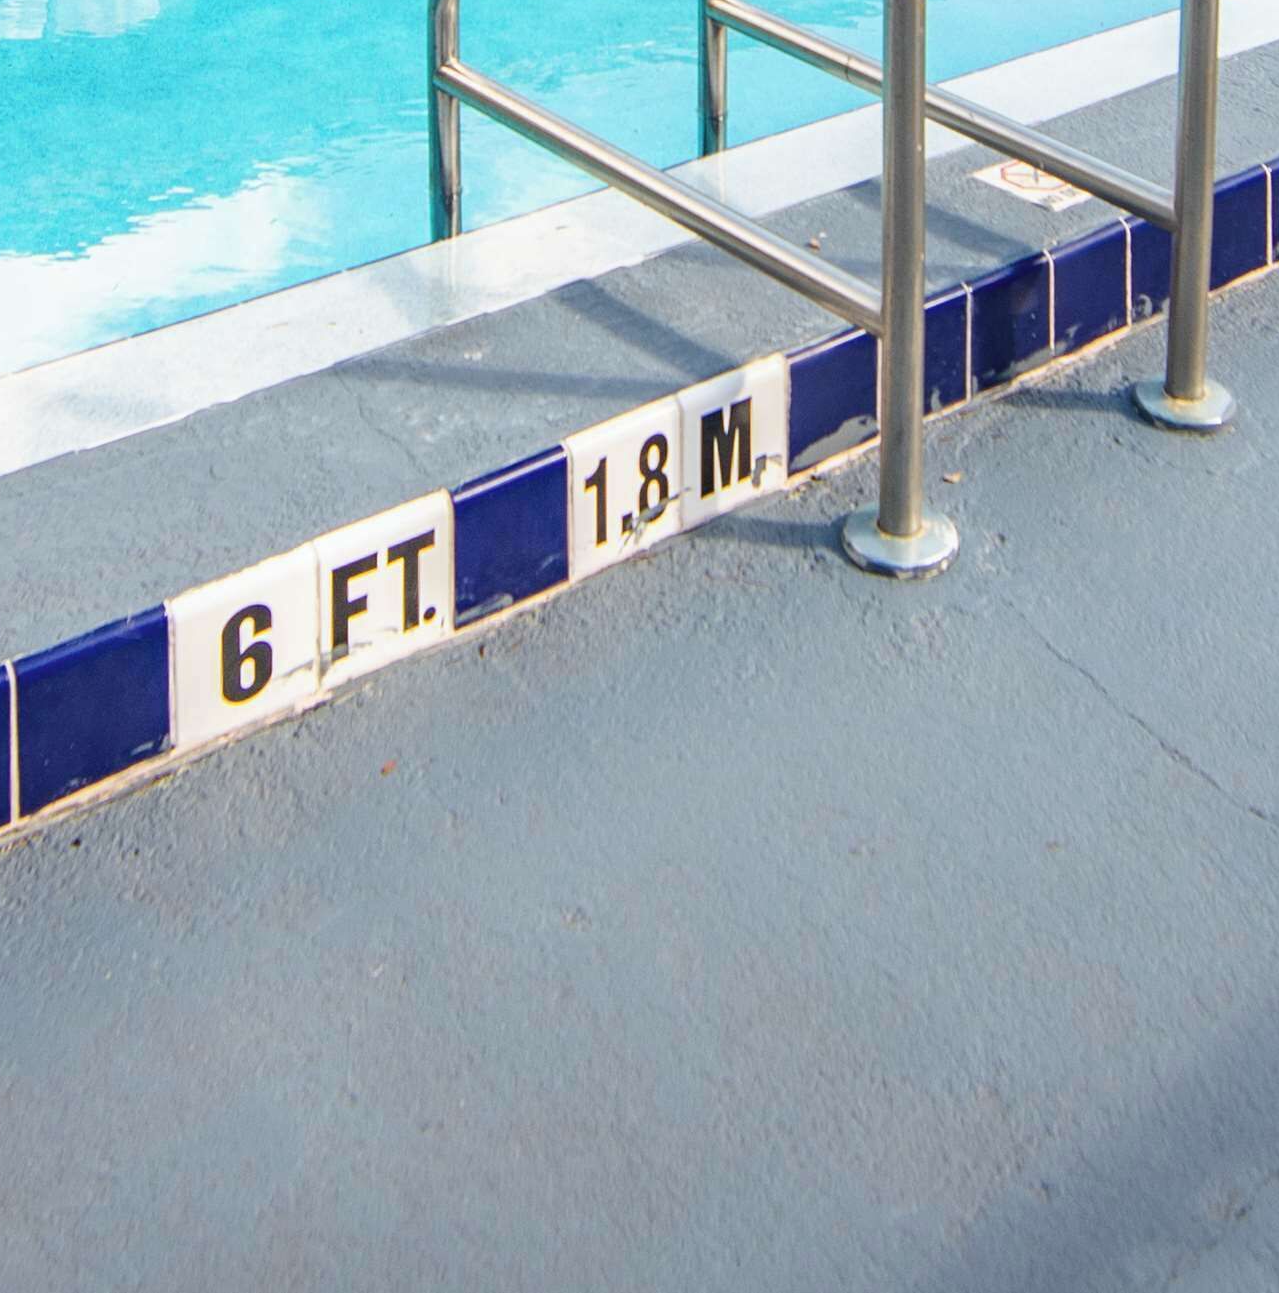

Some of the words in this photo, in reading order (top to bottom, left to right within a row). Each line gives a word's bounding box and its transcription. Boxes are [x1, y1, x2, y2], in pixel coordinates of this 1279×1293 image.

[584, 432, 669, 547] 1.8
[699, 396, 768, 499] M.
[220, 602, 274, 705] 6
[330, 528, 437, 663] FT.
